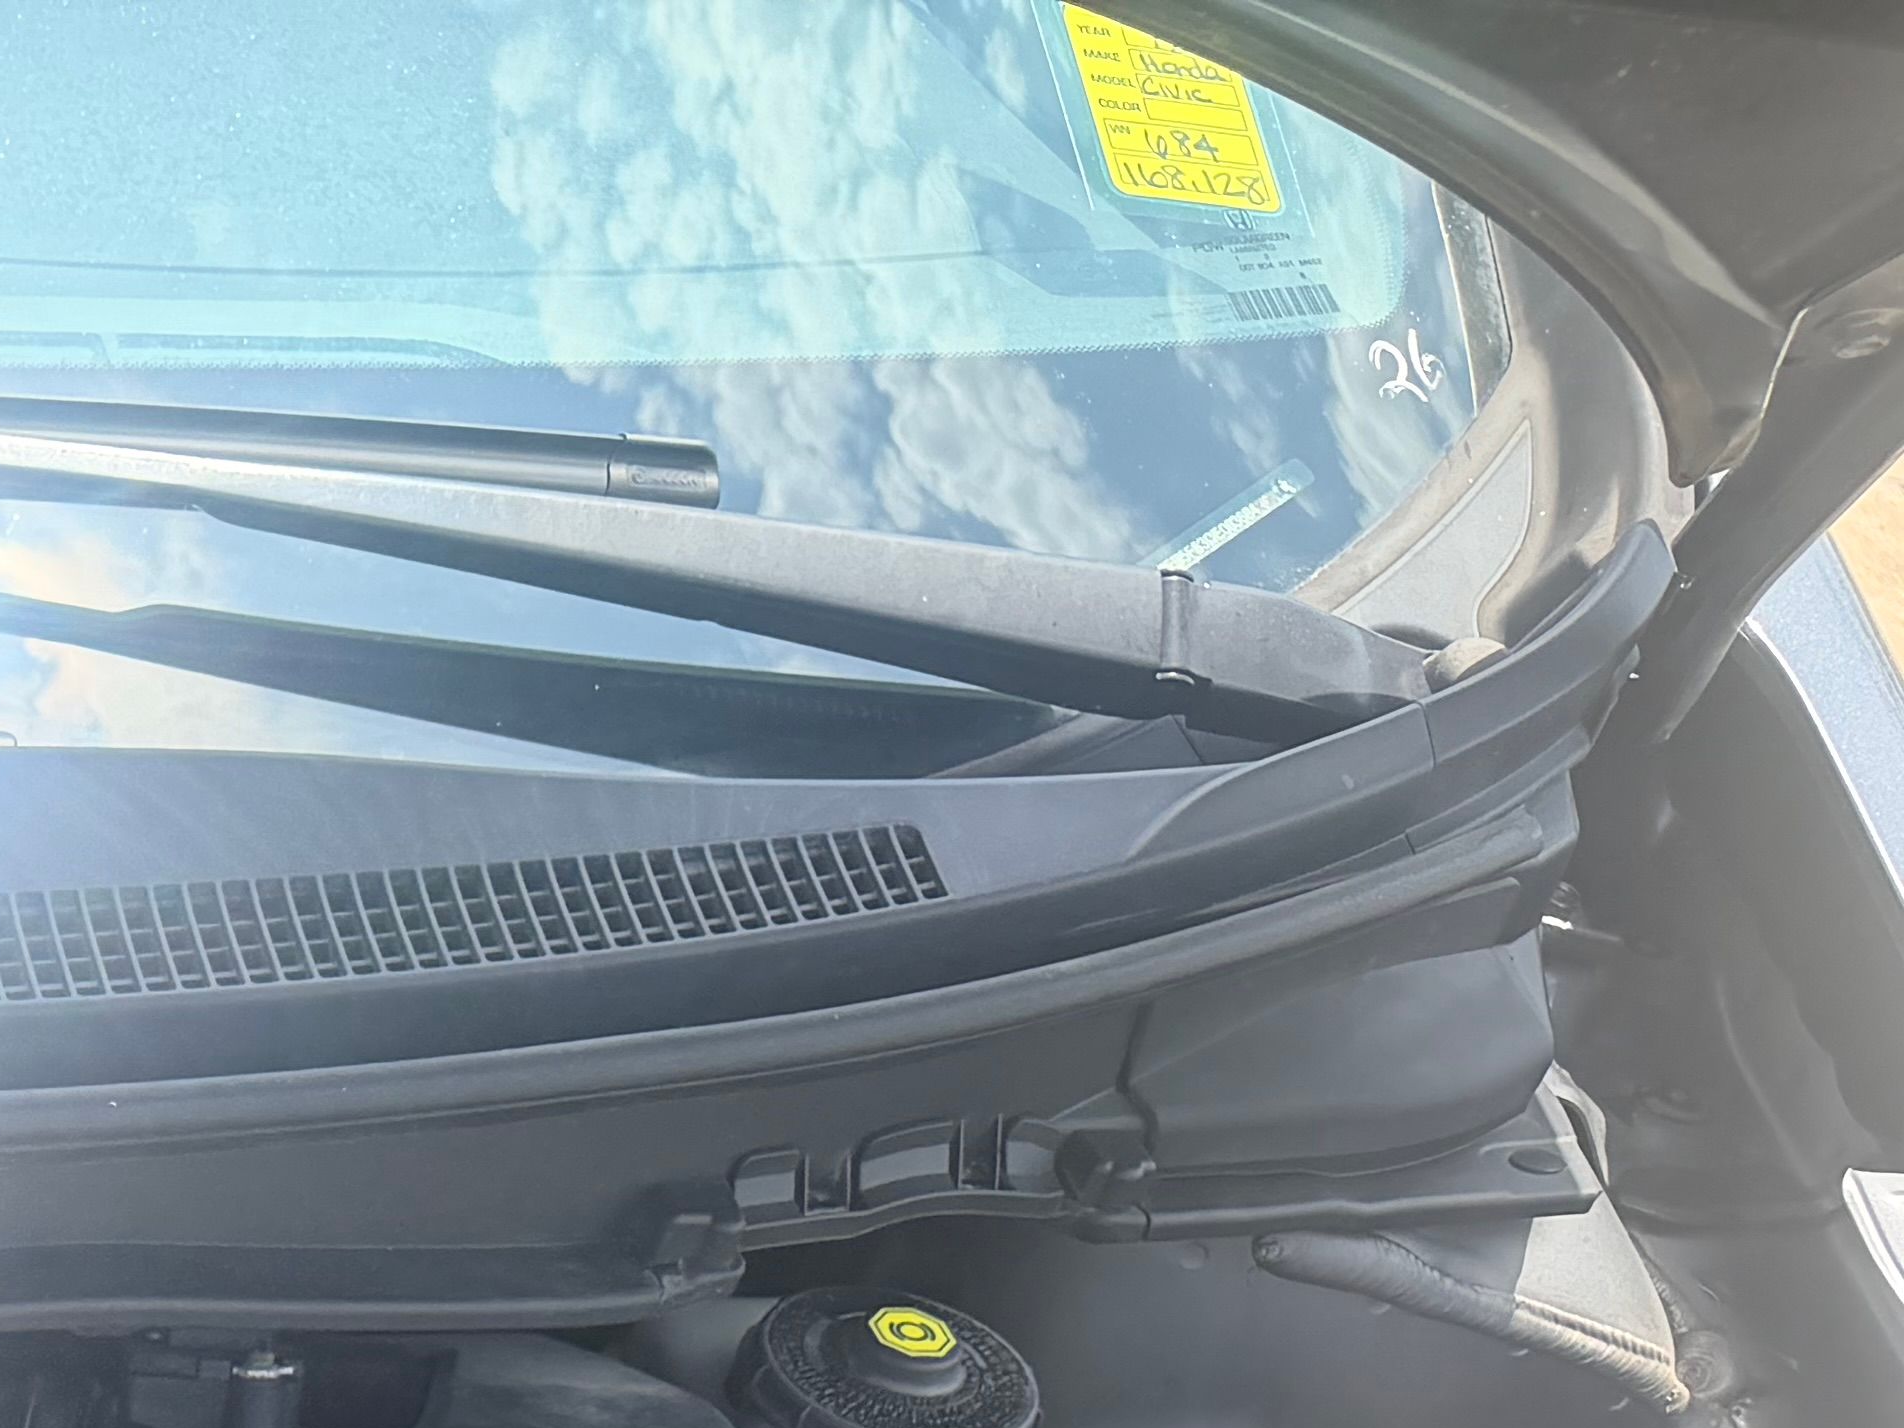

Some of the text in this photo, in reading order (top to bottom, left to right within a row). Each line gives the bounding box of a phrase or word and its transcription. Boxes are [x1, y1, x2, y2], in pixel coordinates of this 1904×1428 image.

[1077, 24, 1111, 38] YEAR
[1082, 48, 1121, 62] MAKE
[1139, 53, 1227, 82] Honda
[1090, 74, 1137, 89] MODEL
[1098, 97, 1142, 113] COLOR
[1144, 128, 1219, 163] 684
[1368, 327, 1447, 402] 26
